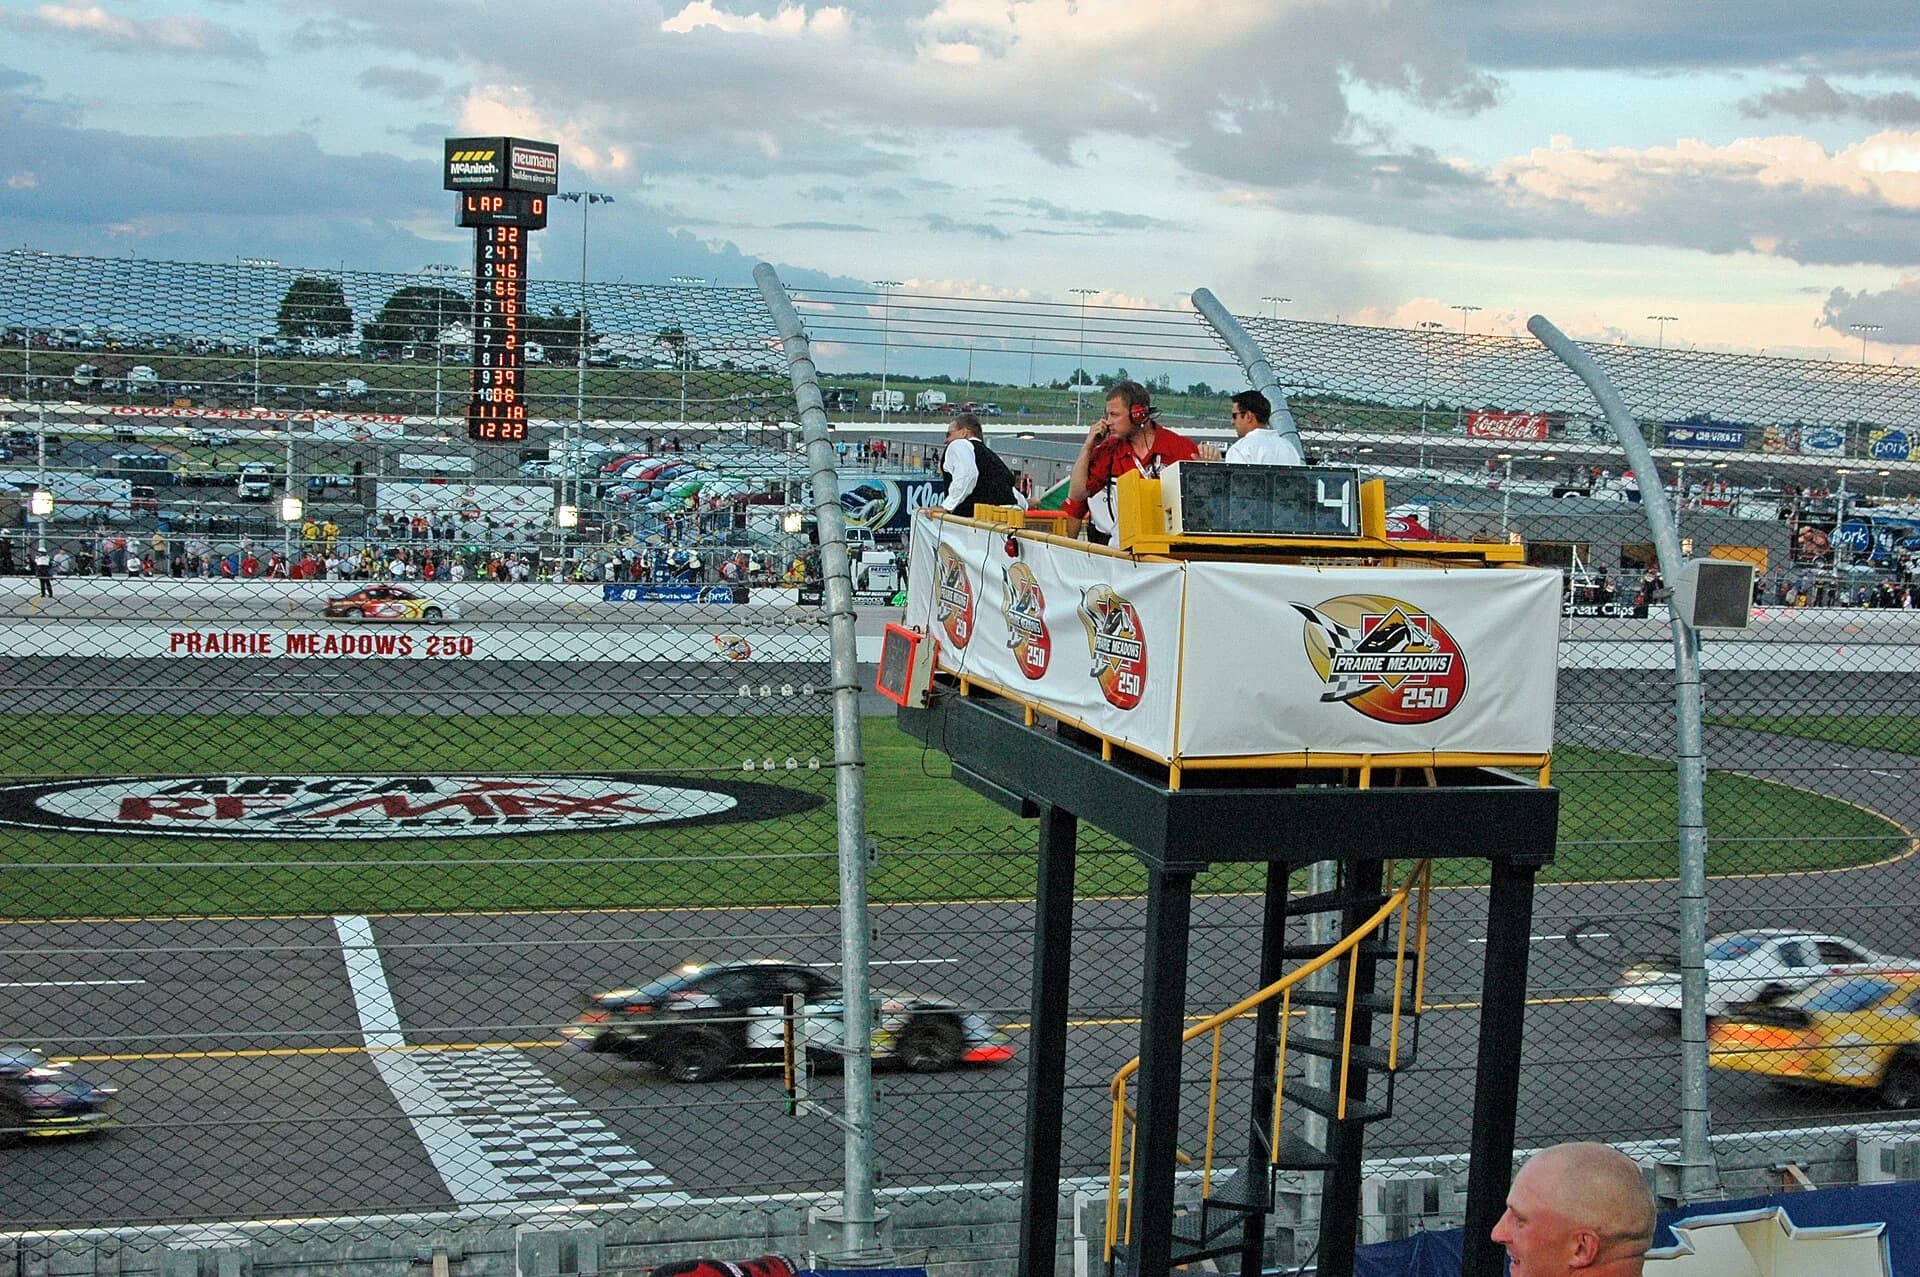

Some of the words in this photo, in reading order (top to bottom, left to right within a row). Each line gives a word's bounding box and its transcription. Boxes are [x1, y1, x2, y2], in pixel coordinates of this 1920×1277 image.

[514, 152, 556, 170] neumann
[468, 196, 503, 211] LAP
[486, 227, 493, 241] 1
[497, 226, 518, 242] 32
[484, 245, 493, 259] 2
[496, 245, 517, 260] 47
[484, 263, 493, 277] 3
[496, 263, 517, 278] 46
[484, 281, 492, 294] 4
[483, 299, 492, 312] 5
[483, 317, 491, 329] 6
[506, 317, 516, 331] 5
[483, 334, 491, 348] 7
[505, 334, 516, 350] 2
[482, 352, 491, 366] 8
[499, 353, 515, 367] 11
[482, 370, 491, 384] 9
[494, 370, 515, 385] 39
[478, 387, 493, 402] 10
[480, 406, 497, 418] 11
[480, 422, 496, 438] 12
[502, 423, 523, 438] 22
[1472, 414, 1541, 438] Coca-Cola
[1316, 478, 1350, 528] 4
[1562, 602, 1599, 615] Great
[1602, 602, 1635, 619] Clips
[170, 632, 272, 654] PRAIRIE
[286, 633, 413, 656] MEADOWS
[425, 635, 474, 657] 250
[1111, 640, 1140, 658] MEADOWS
[1027, 645, 1046, 668] 250
[1335, 657, 1385, 671] PRAIRIE
[1386, 657, 1448, 671] MEADOWS
[1118, 671, 1140, 697] 250
[1401, 688, 1449, 708] 250
[157, 780, 436, 795] ARCA
